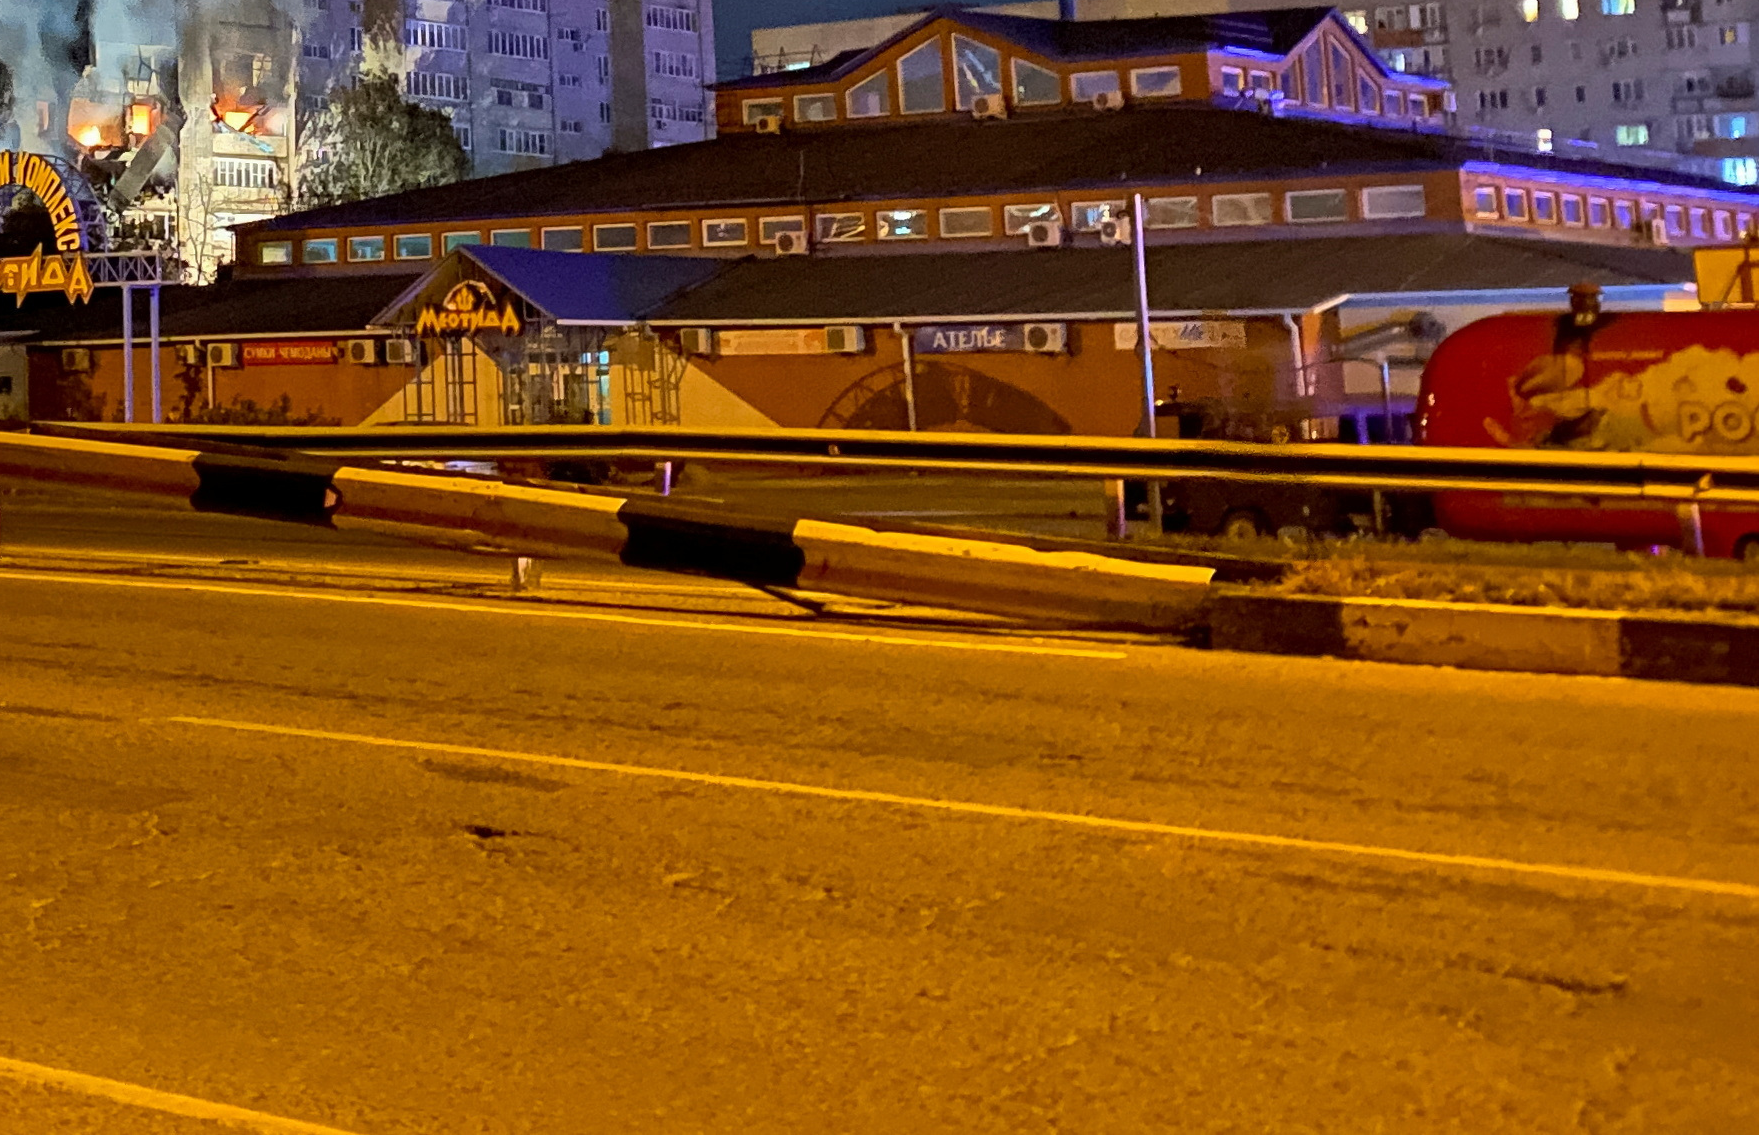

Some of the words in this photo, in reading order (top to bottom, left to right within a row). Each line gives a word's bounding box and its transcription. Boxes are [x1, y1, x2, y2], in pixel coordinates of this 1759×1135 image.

[15, 150, 81, 252] КОМПЛЕКС
[416, 302, 521, 335] МЕОТИДА
[933, 327, 1006, 348] АТЕЛЬЕ
